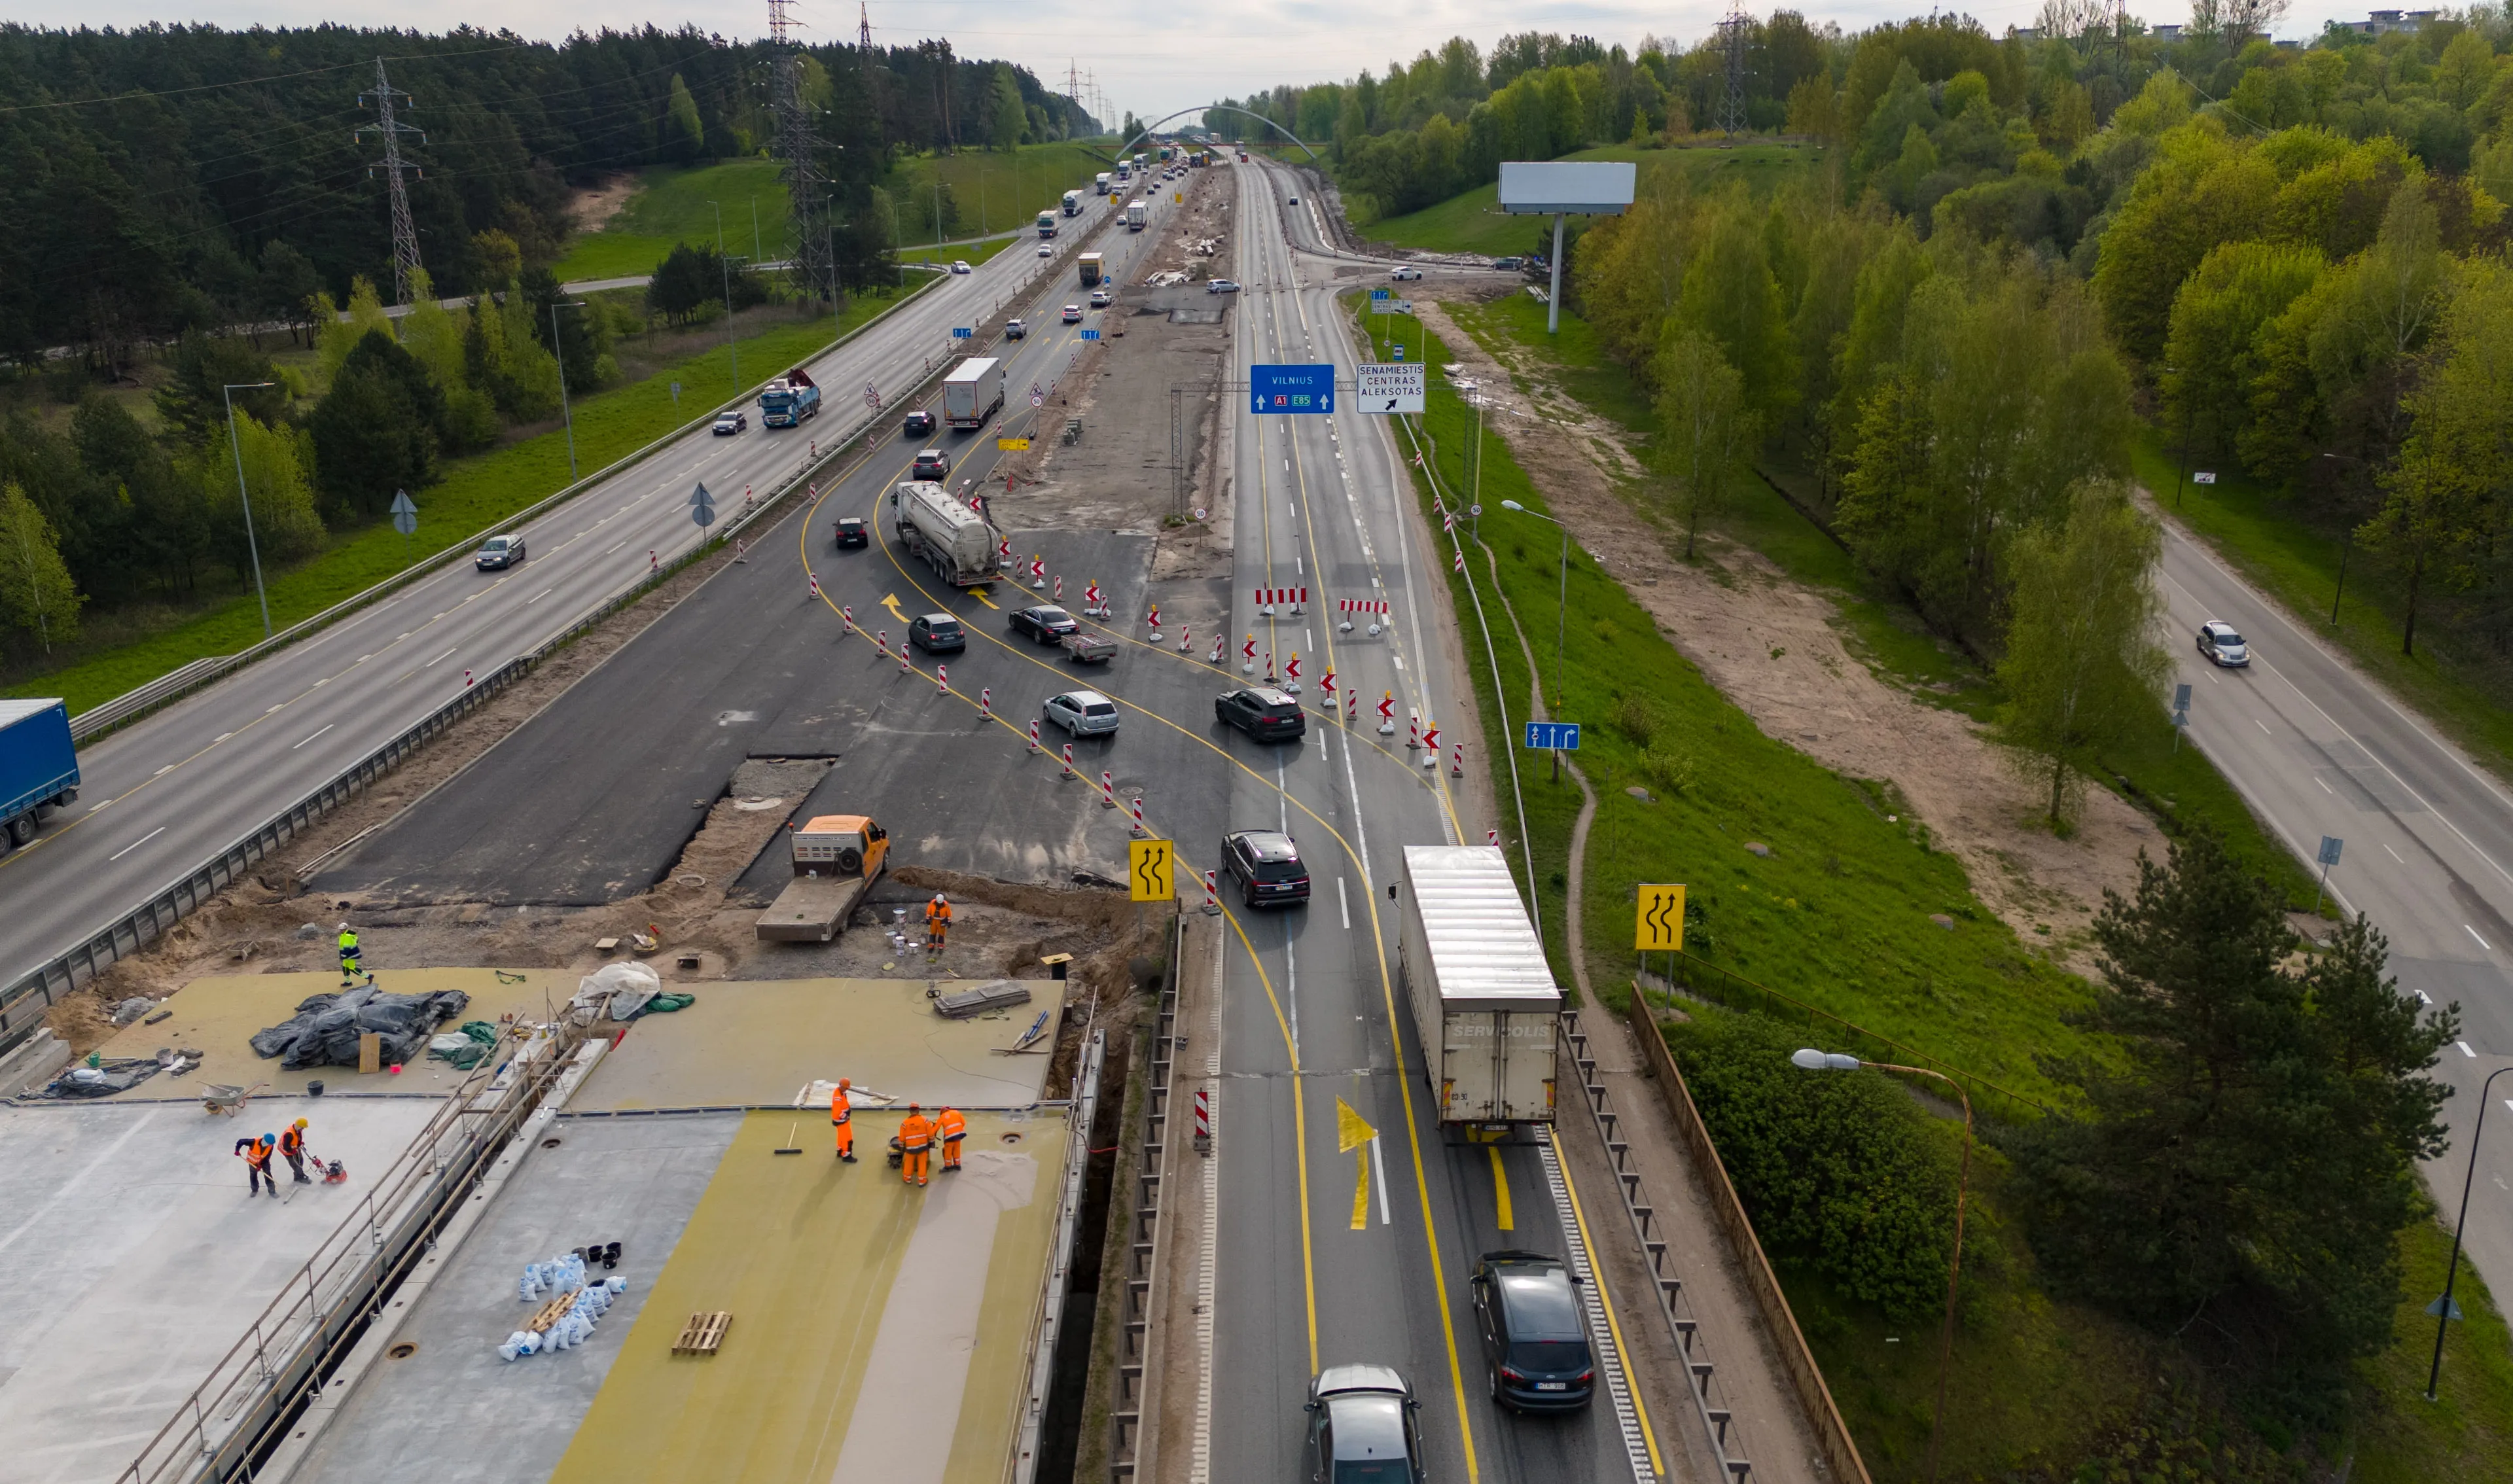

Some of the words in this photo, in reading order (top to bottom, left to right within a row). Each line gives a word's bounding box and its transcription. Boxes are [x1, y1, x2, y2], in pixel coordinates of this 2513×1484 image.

[1360, 366, 1423, 375] SENAMIESTIS
[1272, 376, 1313, 385] VILNIUS
[1367, 376, 1416, 385] CENTRAS
[1361, 387, 1422, 396] ALEKSOTAS
[1276, 397, 1287, 405] A1
[1293, 396, 1310, 405] E85
